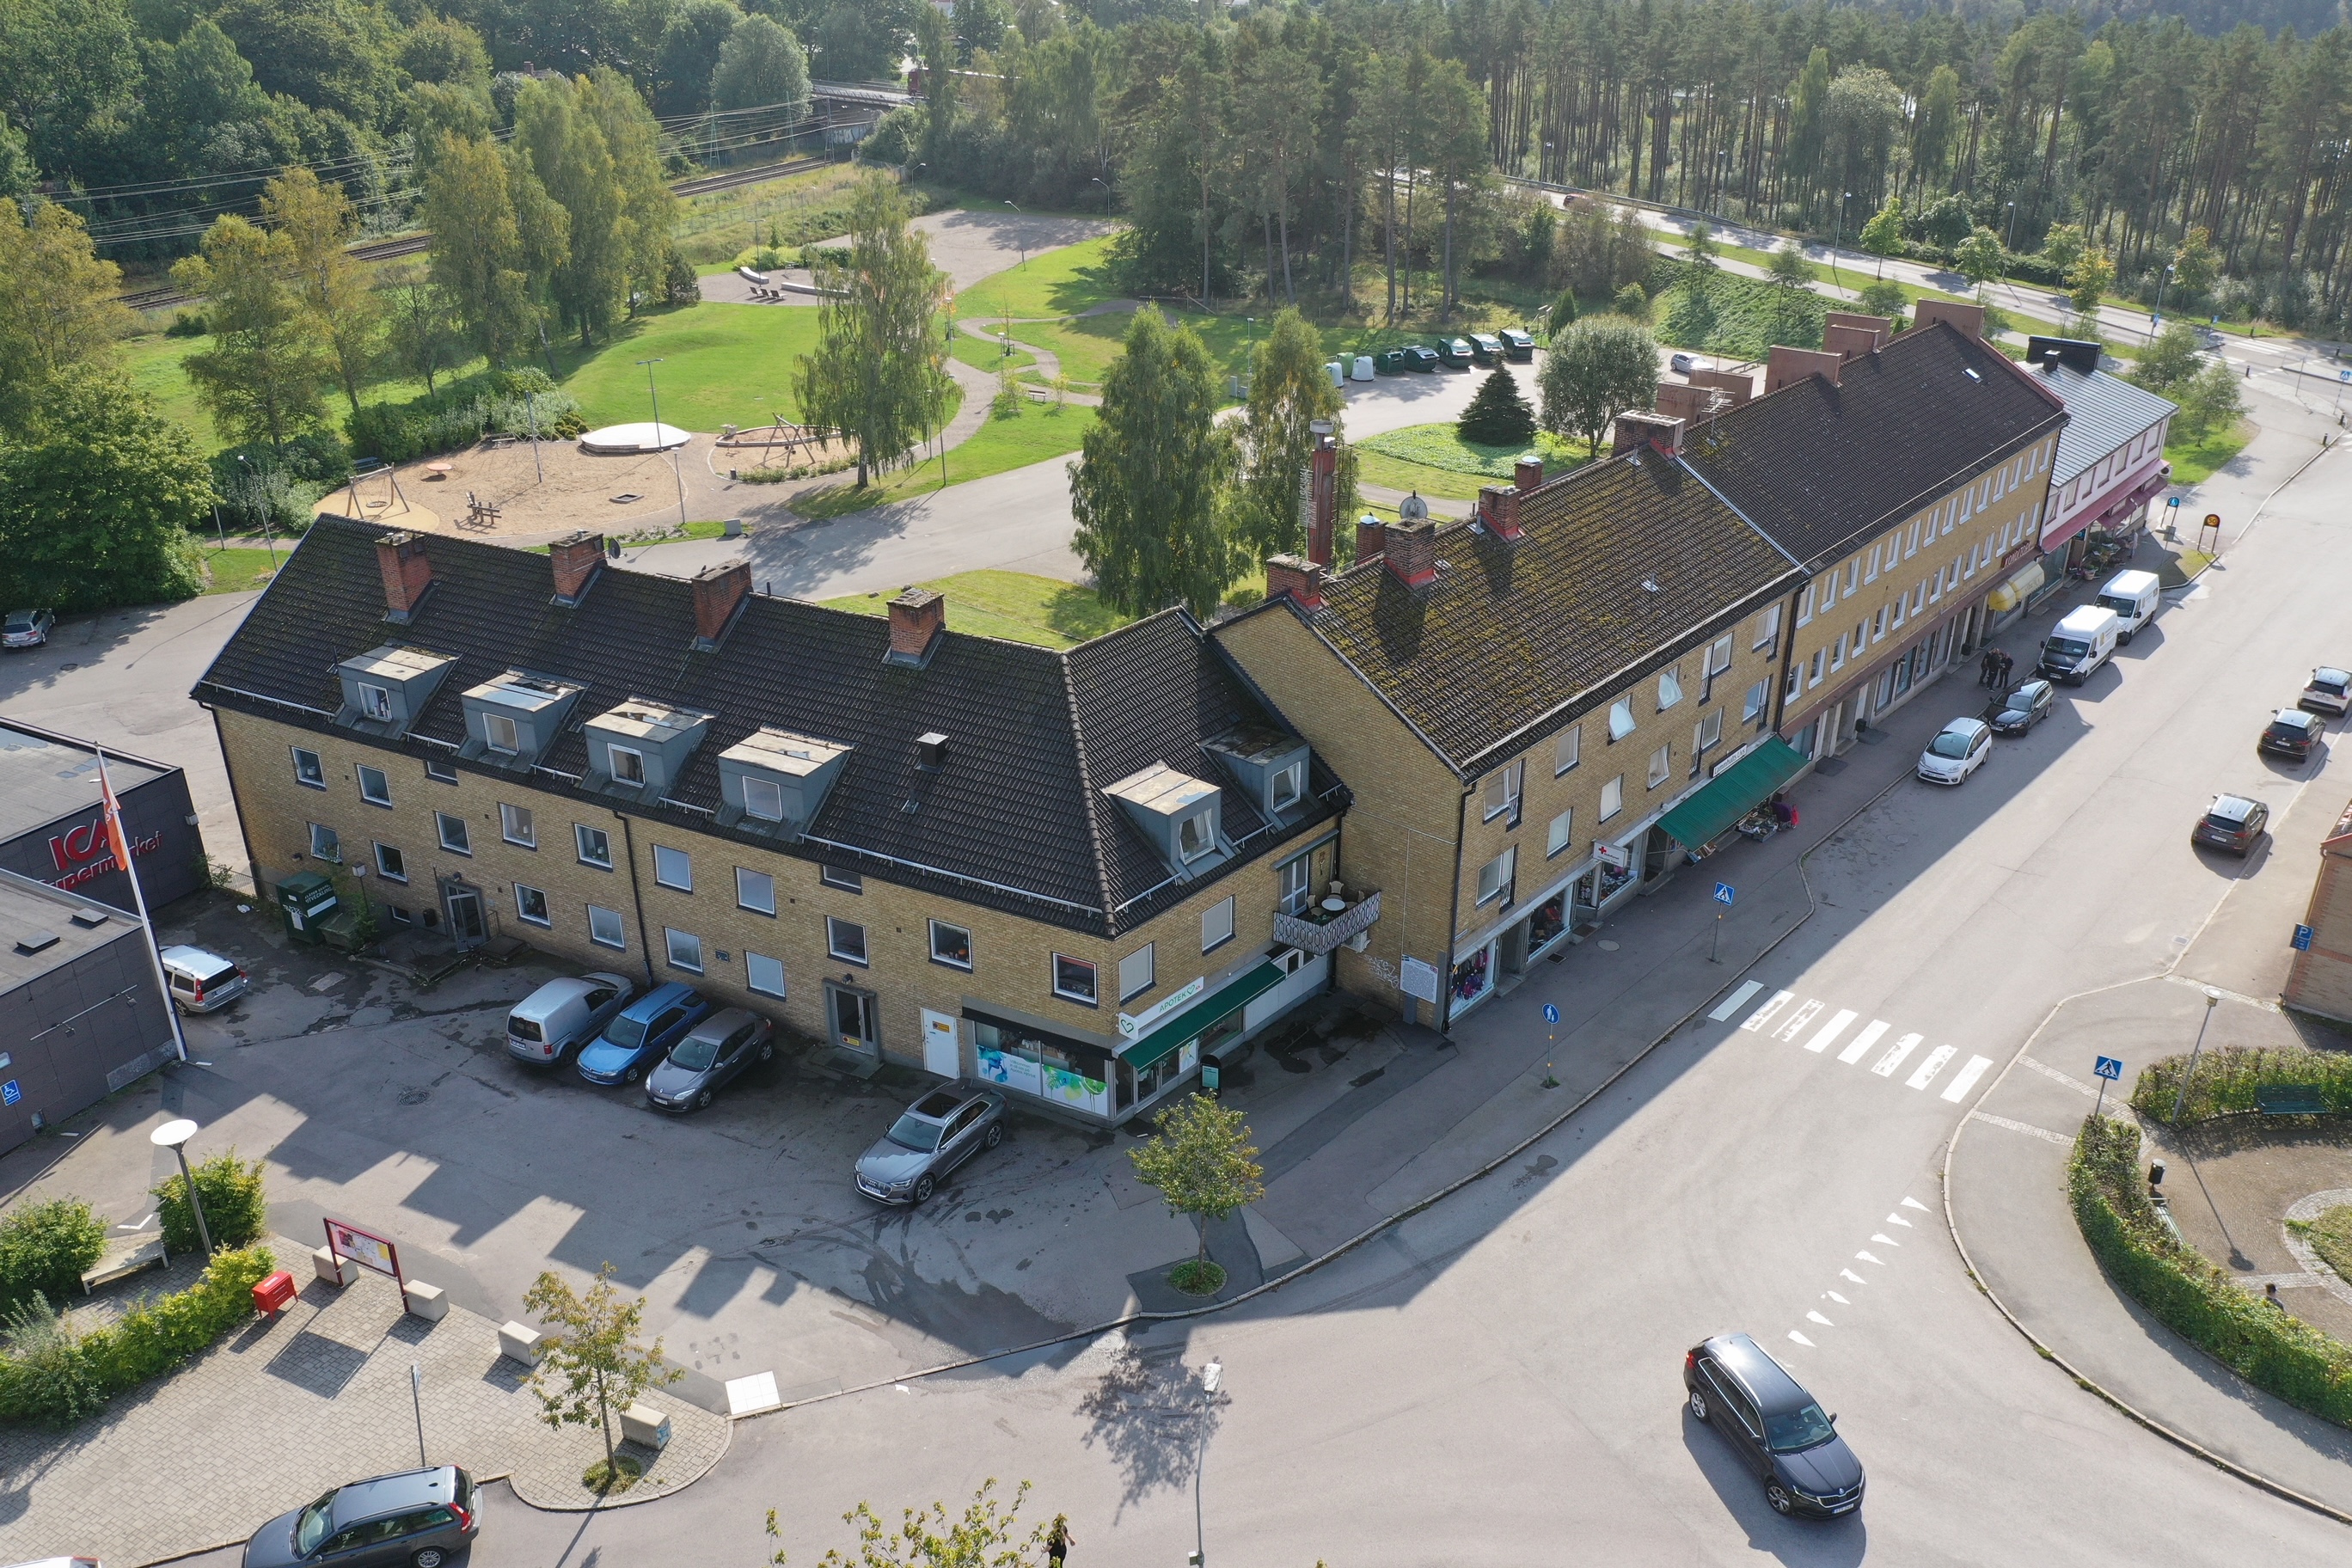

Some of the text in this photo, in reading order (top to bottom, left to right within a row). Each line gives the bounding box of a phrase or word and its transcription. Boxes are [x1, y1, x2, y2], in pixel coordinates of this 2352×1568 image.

[48, 819, 111, 872] ICA
[2299, 927, 2309, 936] P
[1159, 990, 1186, 1013] APOTEK
